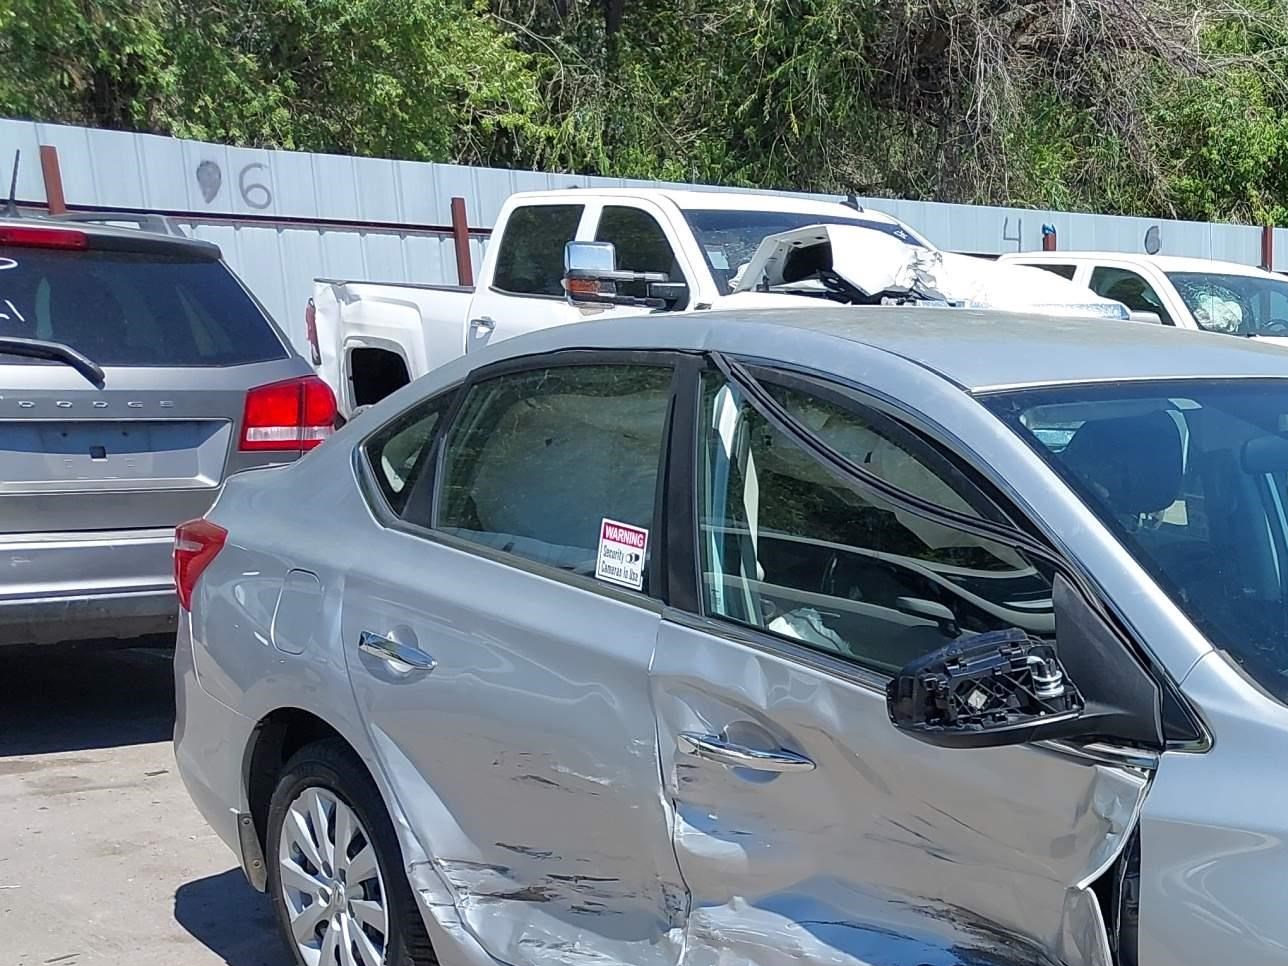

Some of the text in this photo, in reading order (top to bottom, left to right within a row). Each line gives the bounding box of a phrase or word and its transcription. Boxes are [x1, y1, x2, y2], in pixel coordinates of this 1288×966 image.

[18, 400, 176, 408] DODGE
[605, 525, 644, 547] WARNING
[603, 545, 624, 565] Security
